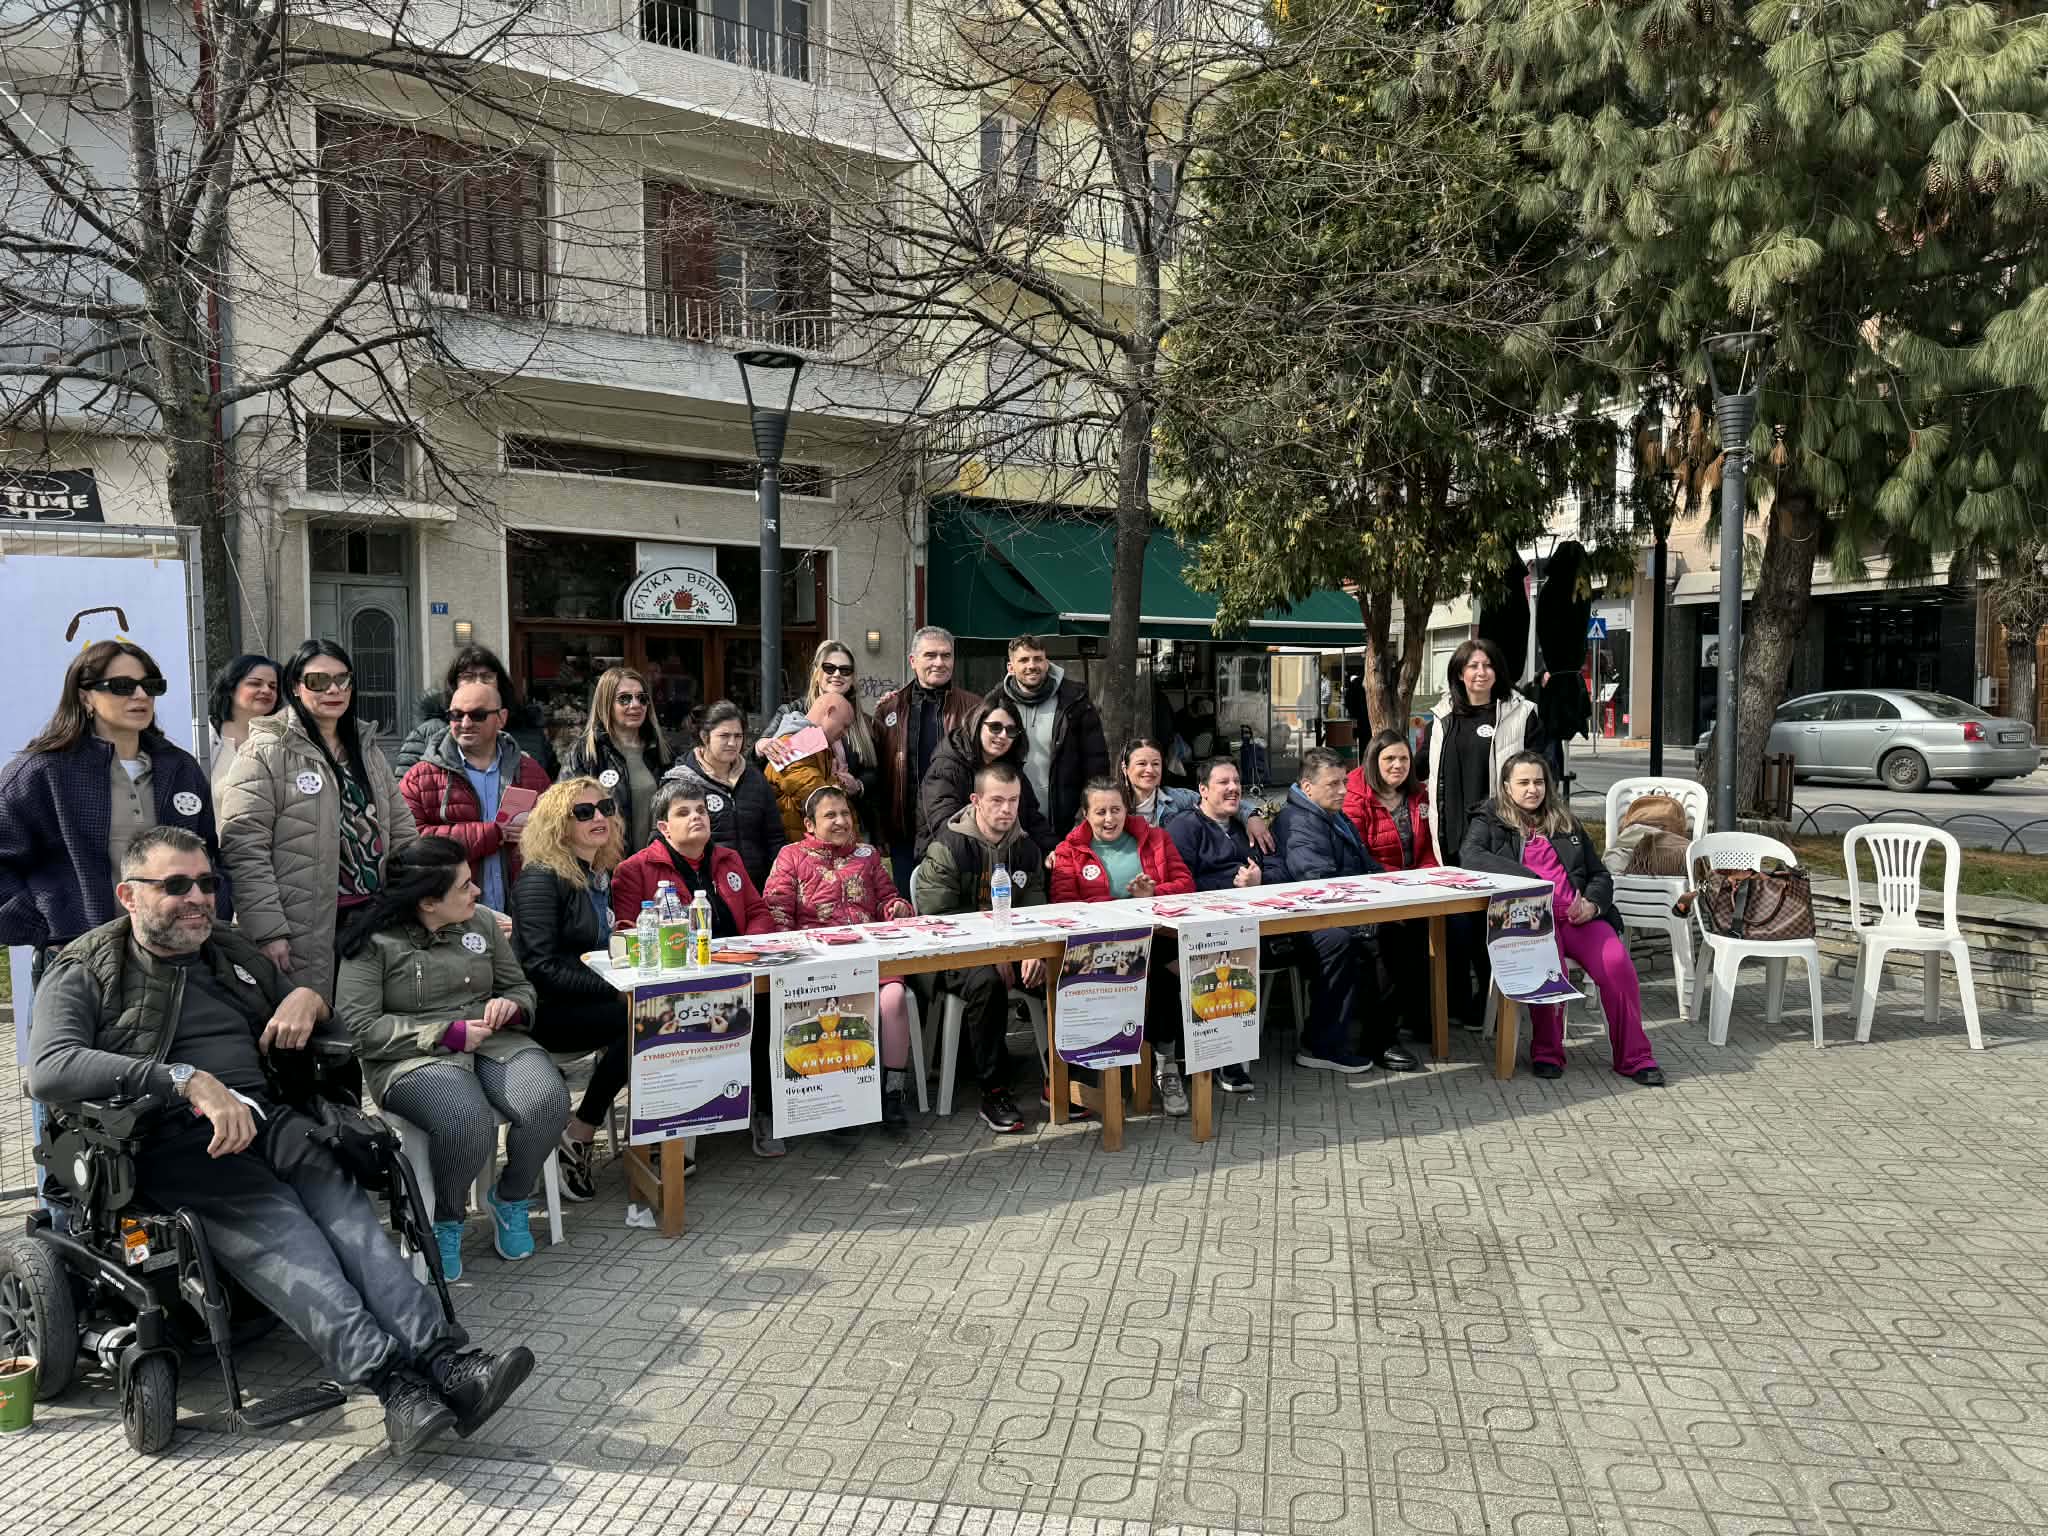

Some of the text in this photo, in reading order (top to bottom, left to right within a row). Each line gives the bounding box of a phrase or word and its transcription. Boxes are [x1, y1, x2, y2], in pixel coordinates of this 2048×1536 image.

[4, 492, 89, 509] TIME
[634, 573, 672, 610] ΓΛΥΚΑ
[821, 1028, 856, 1040] QUIET
[802, 1054, 859, 1068] ANYMORE
